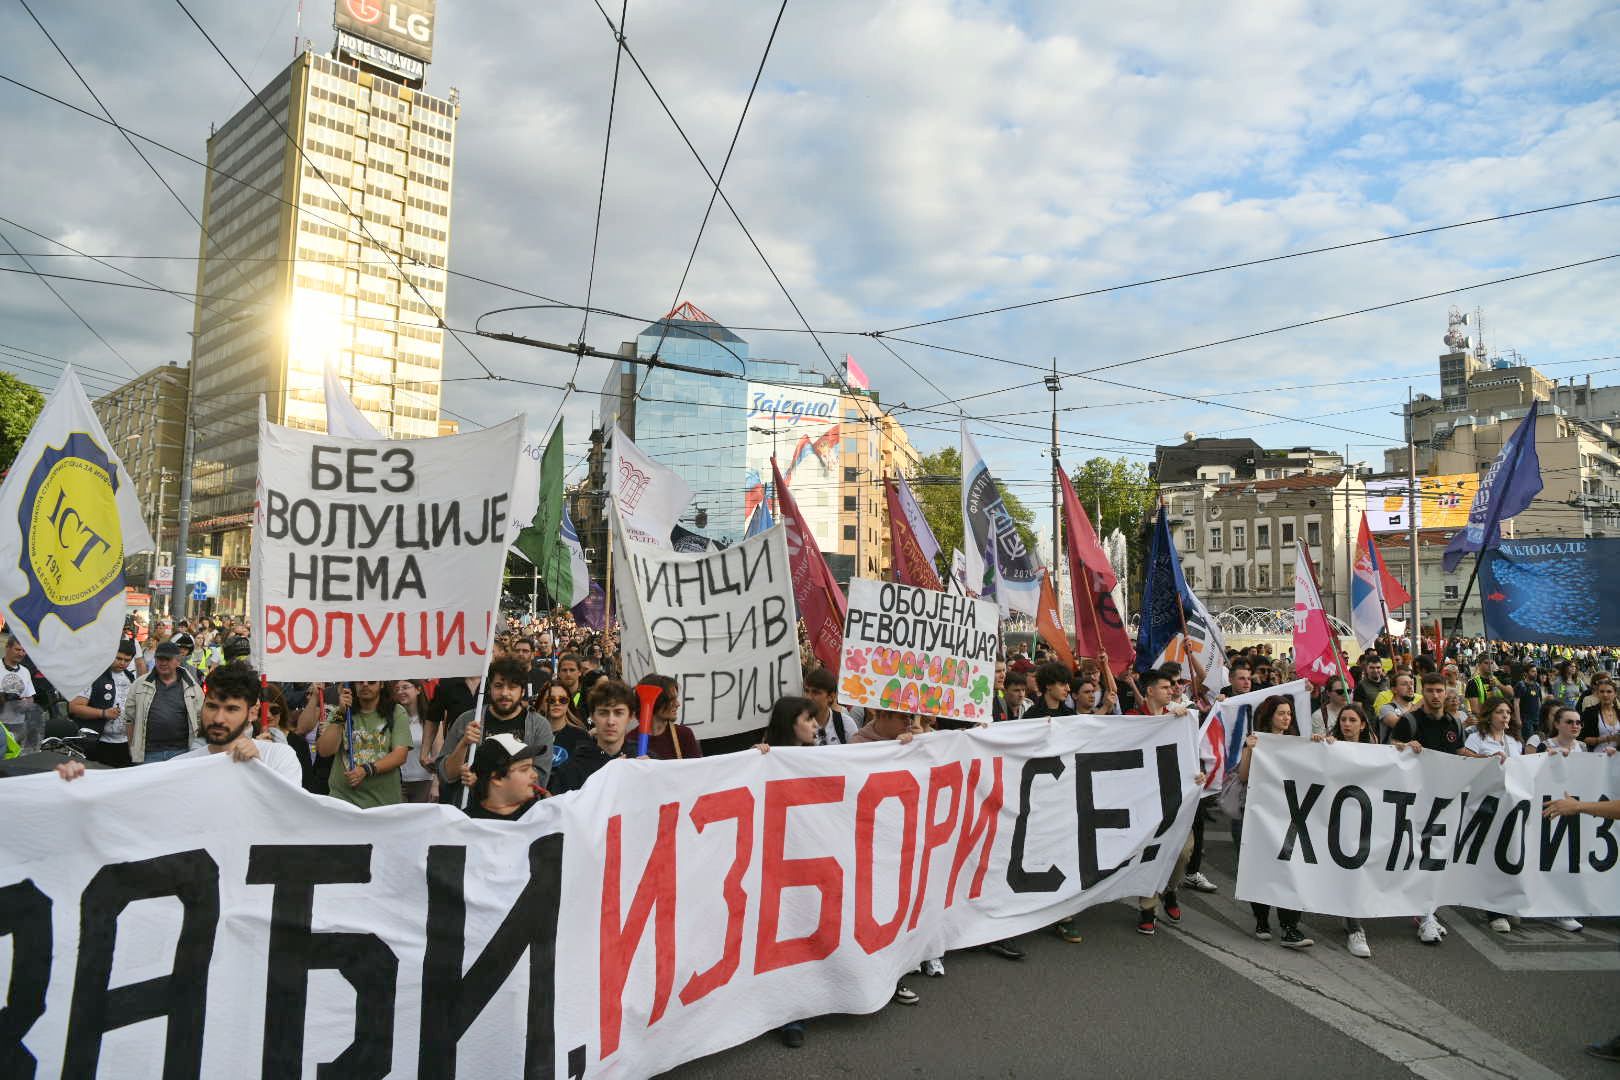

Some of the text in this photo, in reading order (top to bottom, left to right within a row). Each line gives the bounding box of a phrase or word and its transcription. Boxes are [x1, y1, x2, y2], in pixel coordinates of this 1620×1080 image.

[389, 3, 430, 42] LG
[340, 33, 424, 75] HOTEL SLAVIJA
[311, 444, 416, 494] БЕЗ
[266, 489, 508, 551] ВОЛУЦИЈЕ
[287, 552, 427, 602] НЕМА
[880, 583, 976, 629] ОБОЈЕНА
[845, 608, 997, 662] РЕВОЛУЦИЈА?
[674, 651, 793, 726] ЕРИЈЕ
[599, 756, 1004, 1061] ИЗБОРИ
[1006, 743, 1182, 893] СЕ!
